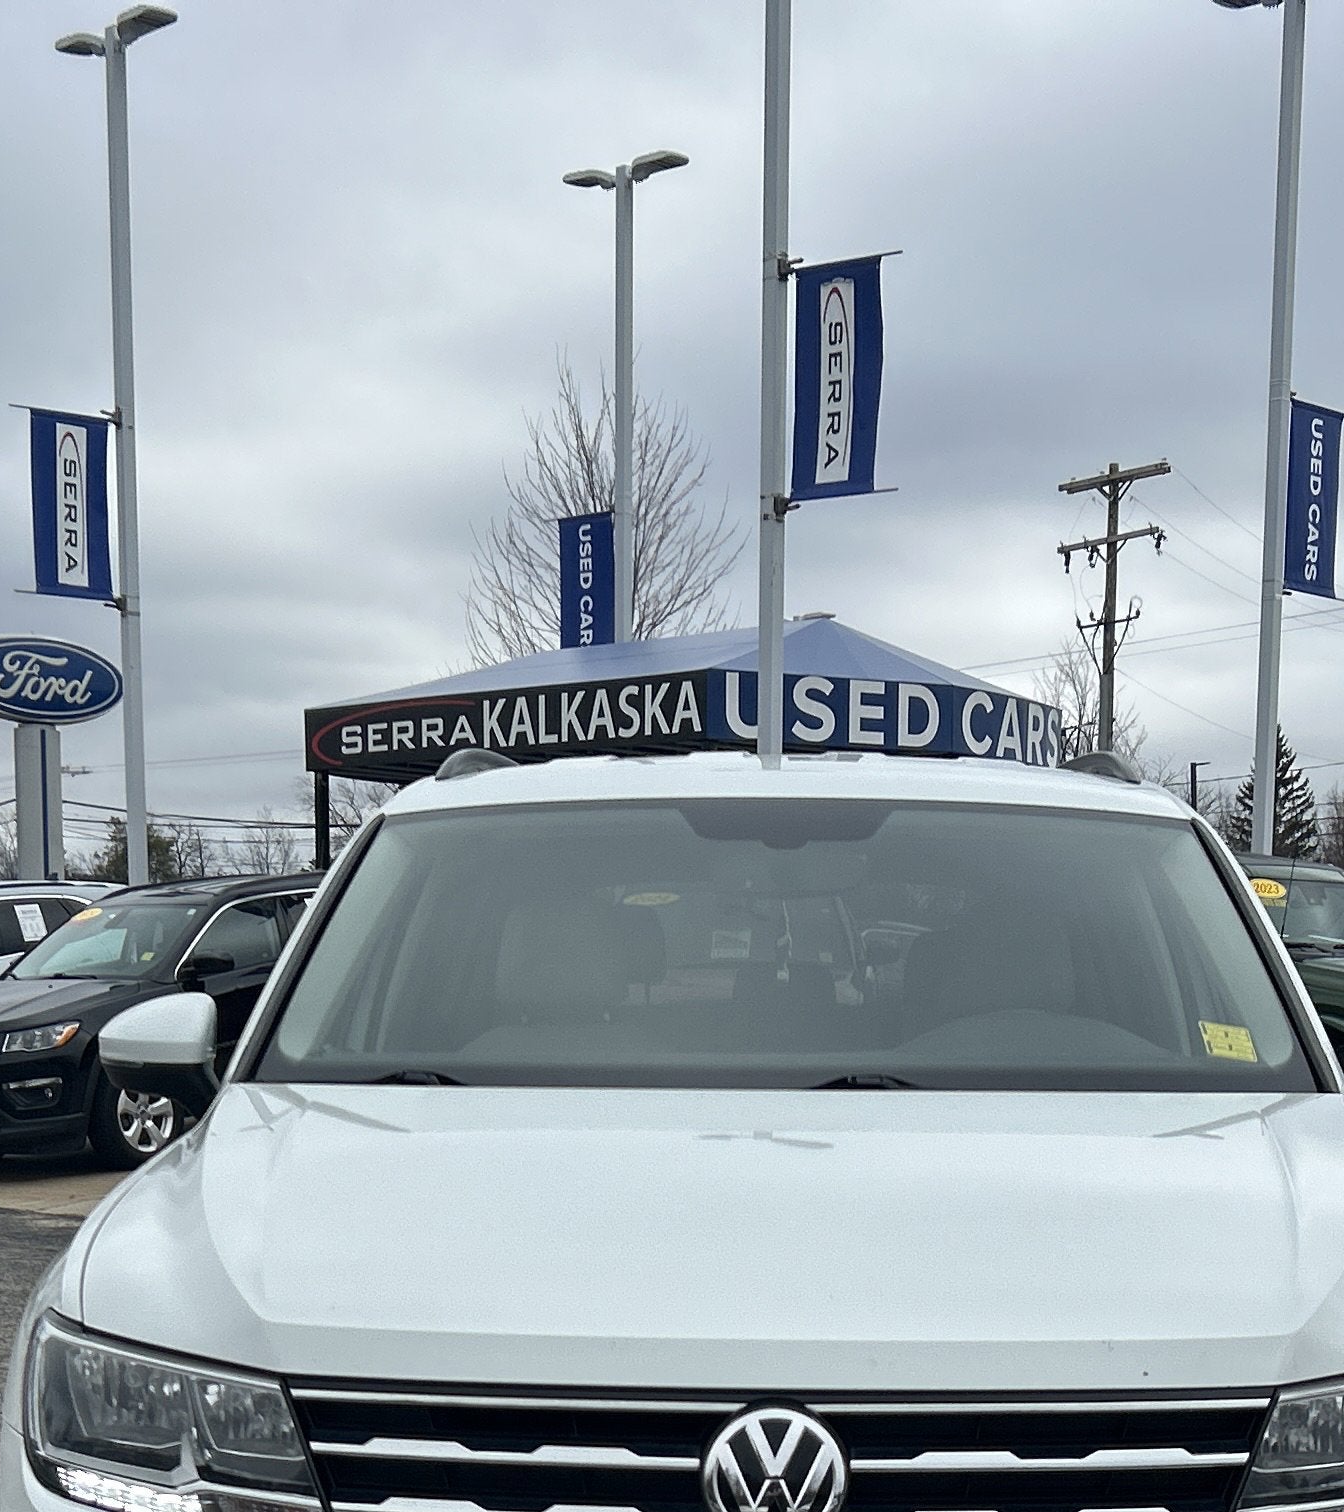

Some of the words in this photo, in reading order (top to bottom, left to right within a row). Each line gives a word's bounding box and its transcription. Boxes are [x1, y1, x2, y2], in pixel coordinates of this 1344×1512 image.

[823, 320, 844, 470] SERRA
[1309, 418, 1324, 496] USED
[62, 457, 78, 574] SERRA
[1304, 502, 1321, 582] CARS
[578, 523, 593, 590] USED
[579, 595, 594, 648] CAR
[340, 714, 477, 755] SERRA
[482, 679, 703, 749] KALKASKA
[724, 671, 940, 748] USED
[961, 691, 1058, 769] CARS
[1253, 881, 1280, 895] 2023
